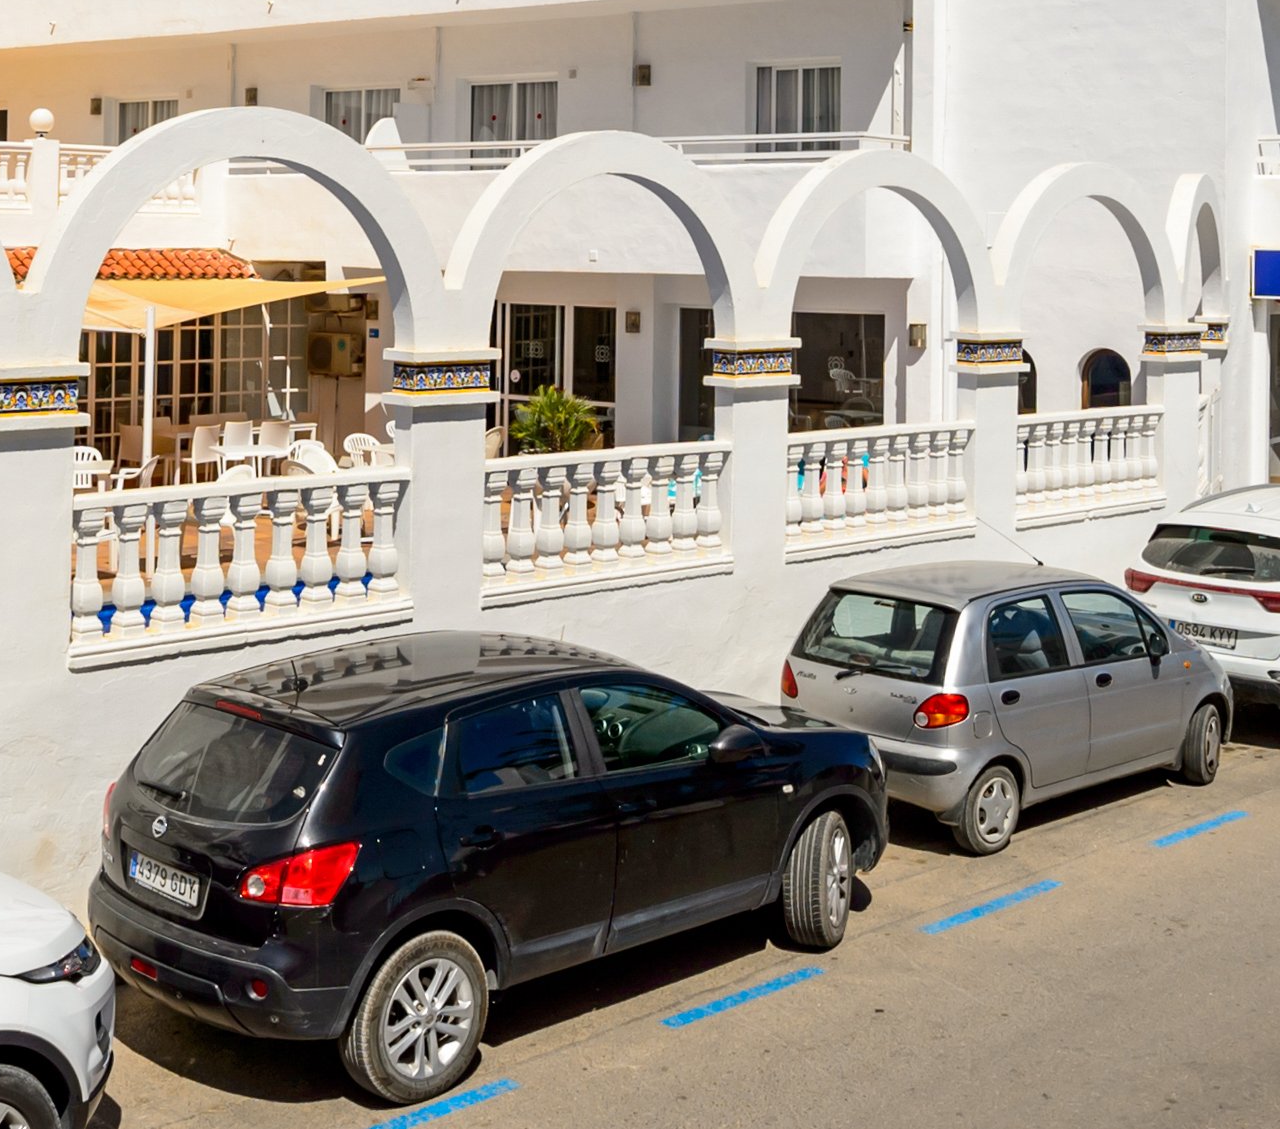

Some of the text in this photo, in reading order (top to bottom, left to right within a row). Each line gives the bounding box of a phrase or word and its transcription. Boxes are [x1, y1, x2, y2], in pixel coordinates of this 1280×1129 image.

[1176, 622, 1234, 643] 0594 KYY
[138, 857, 197, 900] 4379 GDY
